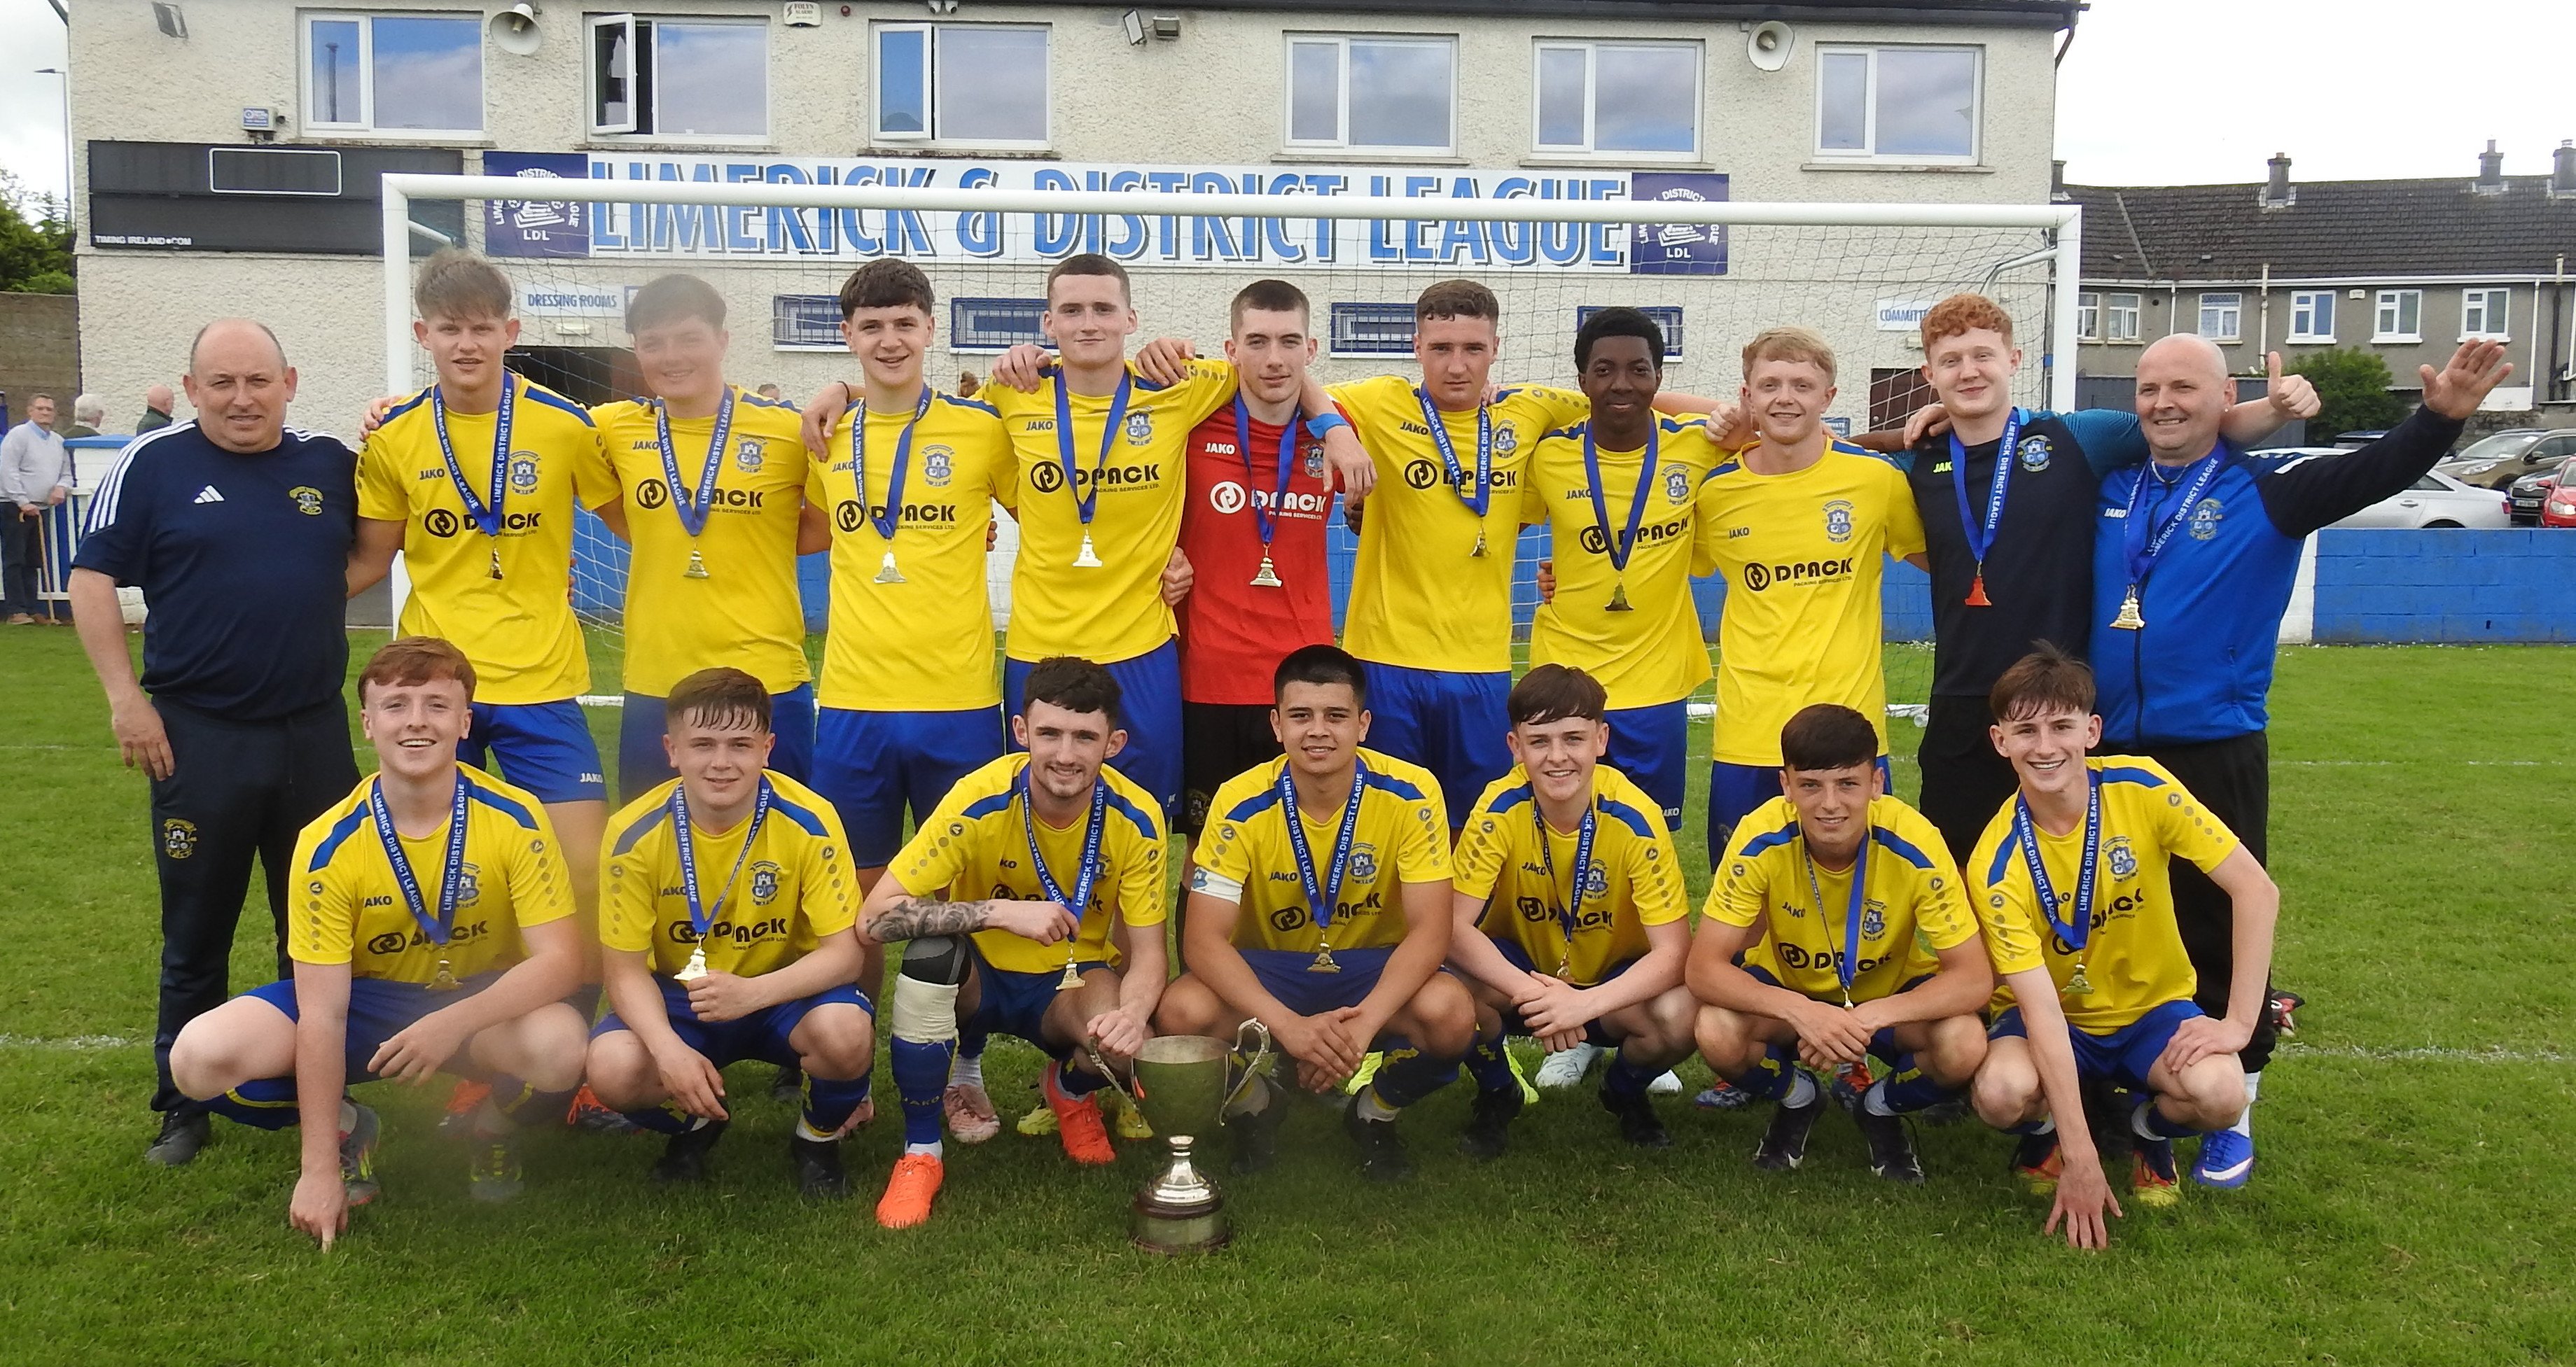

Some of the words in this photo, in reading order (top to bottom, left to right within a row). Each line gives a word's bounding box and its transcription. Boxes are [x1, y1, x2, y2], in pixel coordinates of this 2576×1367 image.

[517, 168, 563, 178] DISTRIC
[592, 161, 937, 257] LIMERICK
[957, 167, 1006, 257] &
[1034, 169, 1349, 262] DISTRICT
[1369, 174, 1626, 267] LEAGUE
[524, 230, 550, 241] LDL
[1666, 248, 1691, 258] LDL
[528, 294, 577, 307] DRESSING
[579, 295, 617, 307] ROOMS
[497, 422, 509, 461] DISTRICT
[1026, 421, 1052, 430] JAKO
[1400, 421, 1428, 435] JAKO
[1423, 397, 1440, 433] LIMERICK
[1436, 430, 1454, 465] DISTRICT
[632, 441, 660, 450] JAKO
[700, 464, 716, 505] LIMERICK
[709, 427, 725, 463] DISTRICT
[720, 398, 732, 427] LEAGUE
[1205, 443, 1235, 455] JAKO
[419, 468, 445, 480] JAKO
[494, 461, 505, 503] LIMERICK
[1933, 461, 1953, 473] JAK
[1996, 456, 2009, 495] DISTRICT
[457, 475, 478, 509] LEAGUE
[669, 472, 687, 507] LEAGUE
[683, 487, 764, 507] ACK
[1566, 489, 1592, 500] JAKO
[2175, 486, 2200, 521] DISTRICT
[2198, 457, 2219, 489] LEAGUE
[464, 512, 541, 530] DCK
[871, 505, 956, 521] DACK
[1988, 496, 2001, 530] LEAGUE
[1775, 557, 1853, 582] DPACK
[580, 773, 603, 783] JAKO
[676, 785, 687, 826] LIMERICK
[450, 822, 464, 864] DISTRICT
[679, 826, 692, 869] DISTRICT
[1075, 866, 1092, 907] LIMERICK
[1085, 822, 1101, 865] DISTRICT
[1094, 785, 1105, 822] LEAGUE
[1282, 776, 1295, 820] LIMERICK
[1290, 820, 1308, 861] DISTRICT
[1302, 860, 1317, 896] LEAGUE
[1330, 852, 1344, 894] LIMERICK
[1339, 811, 1356, 851] DISTRICT
[1352, 773, 1363, 810] LEAGUE
[373, 792, 390, 839] LIMERICK
[387, 836, 409, 878] DISTRICT
[403, 878, 423, 913] LEAGUE
[1028, 831, 1045, 874] DISTRICT
[1580, 832, 1591, 871] DISTRICT
[2018, 806, 2031, 849] LIMERICK
[2028, 849, 2047, 890] DISTRICT
[2042, 890, 2056, 924] LEAGUE
[2080, 868, 2091, 911] LIMERICK
[2087, 825, 2096, 867] DISTRICT
[364, 895, 393, 908] AKO
[444, 866, 457, 911] LIMERICK
[684, 869, 697, 902] LEAGUE
[1782, 902, 1806, 918] JAKO
[713, 918, 786, 942] DACK
